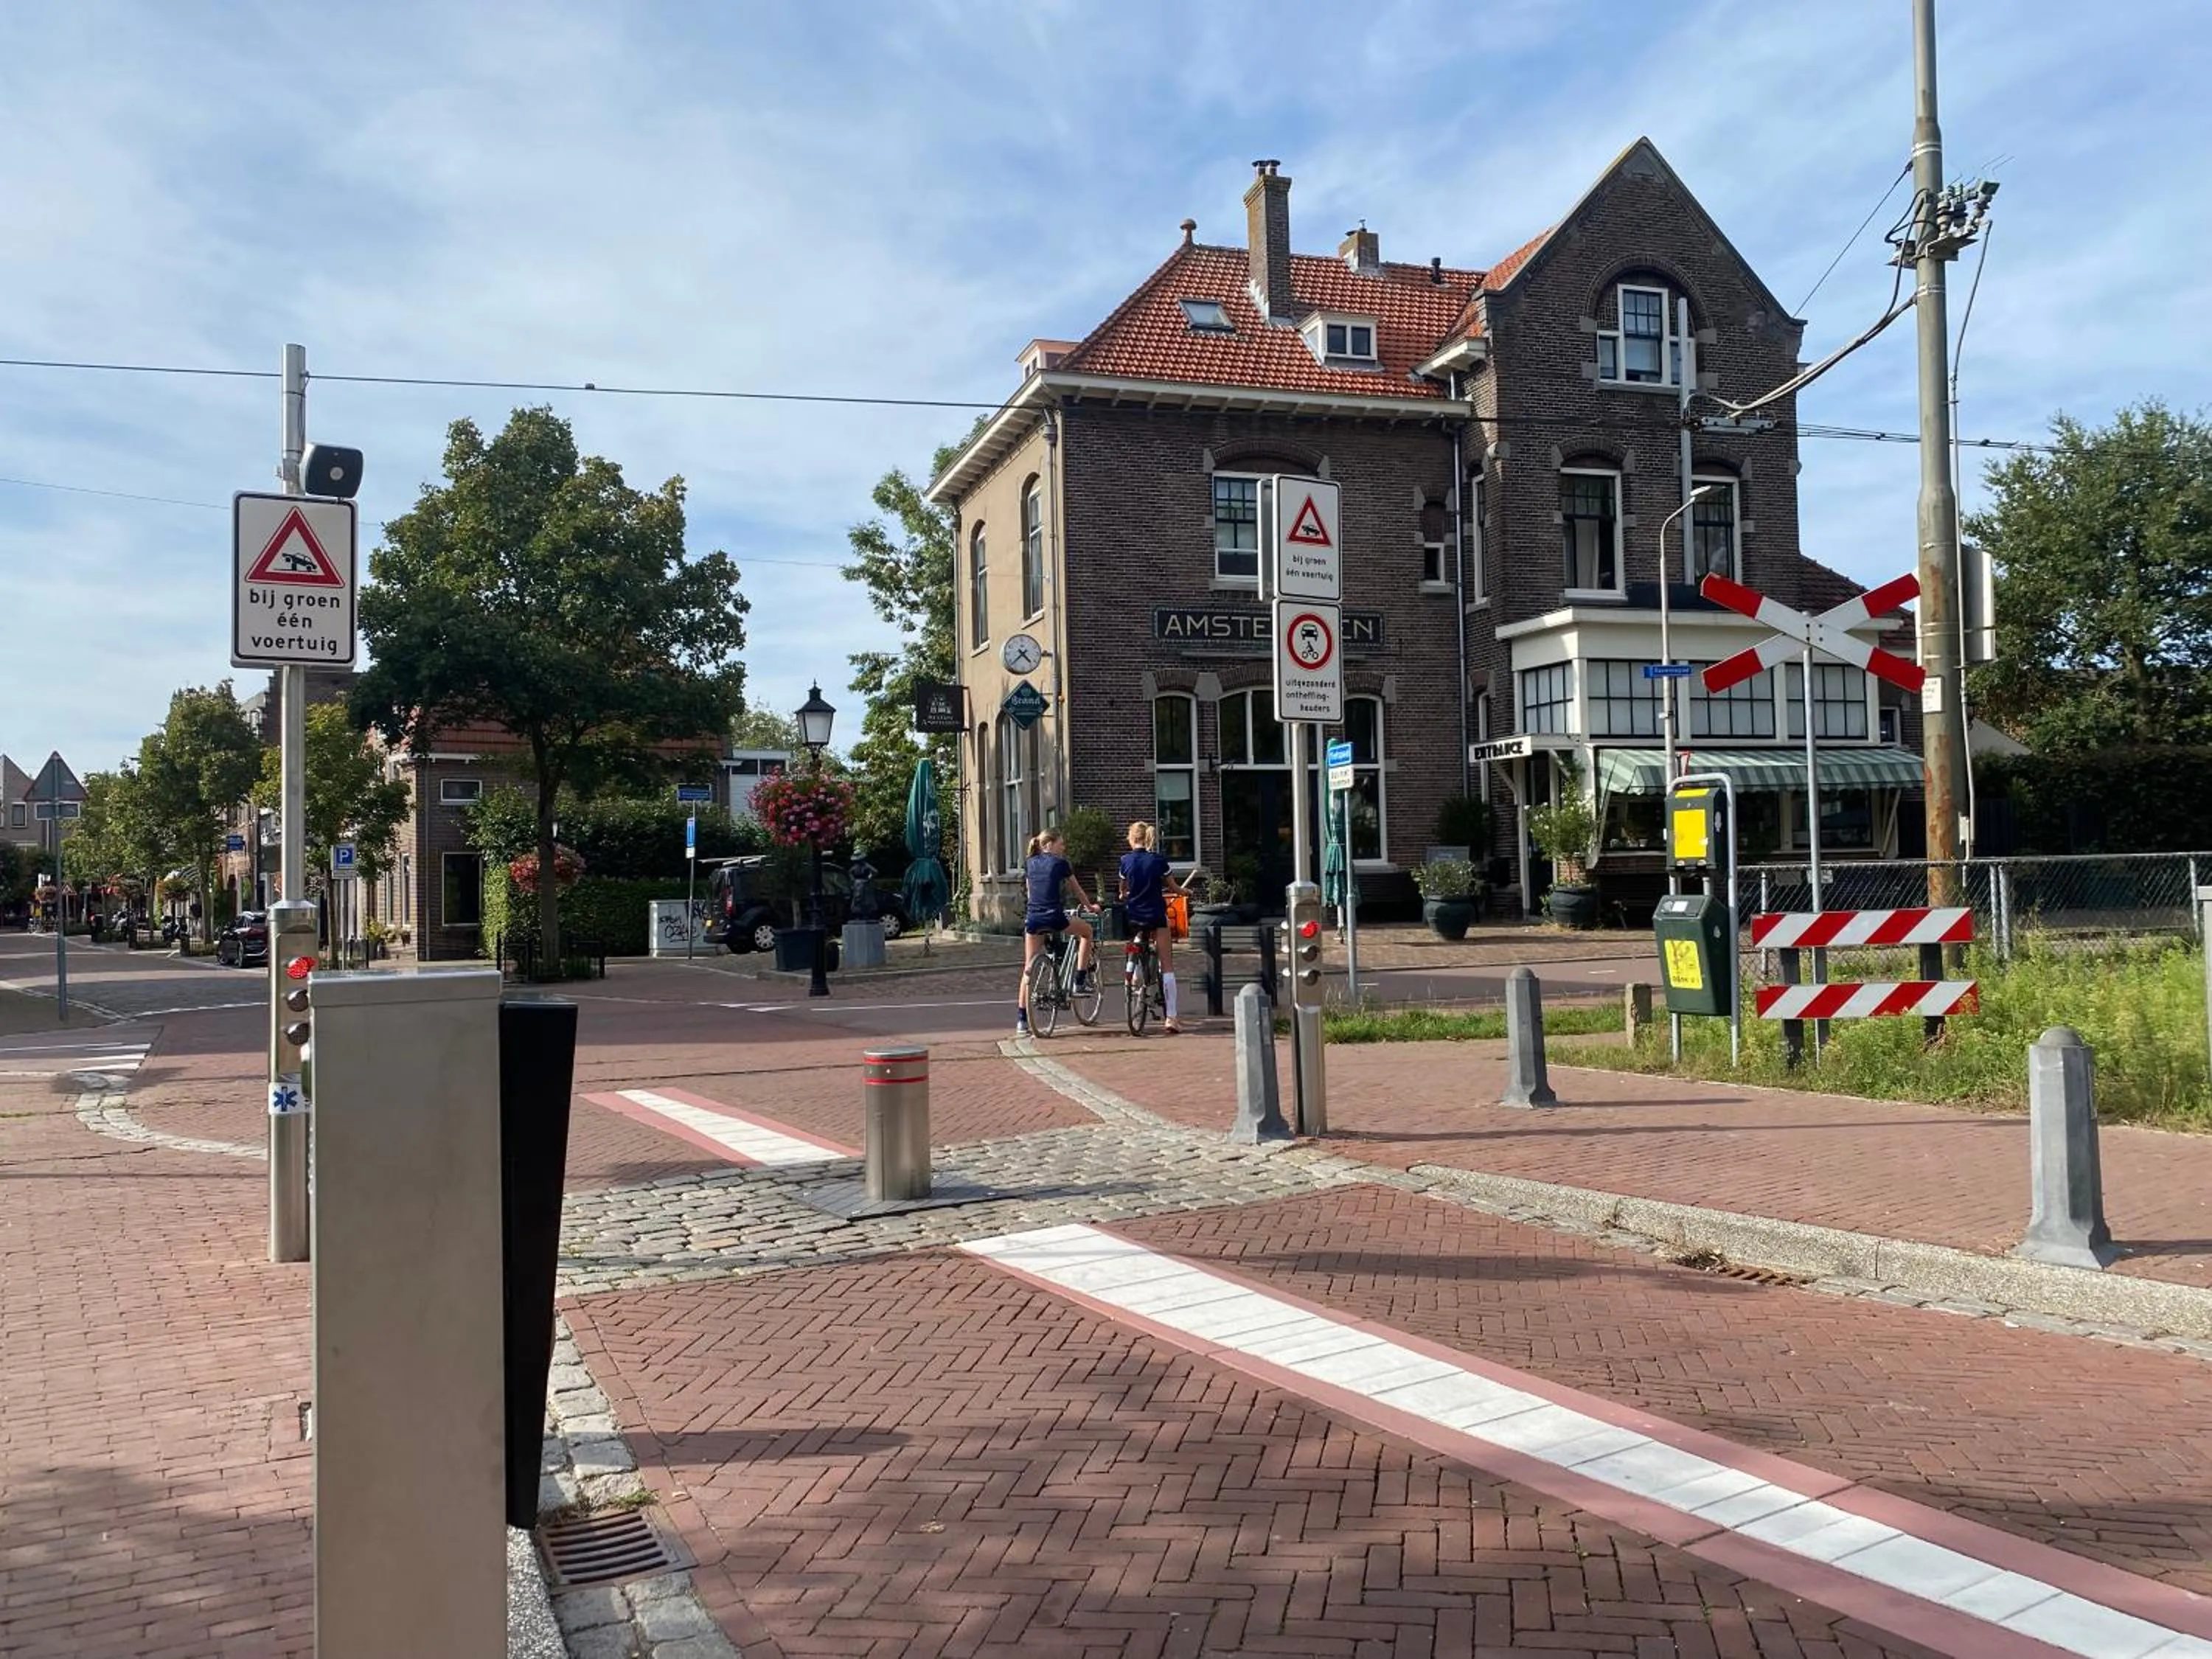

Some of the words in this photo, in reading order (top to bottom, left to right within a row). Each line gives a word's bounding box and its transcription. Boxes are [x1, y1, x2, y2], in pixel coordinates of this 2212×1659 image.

[1293, 554, 1303, 566] bij
[1304, 557, 1326, 566] groen
[1301, 571, 1334, 582] voertuig
[249, 590, 275, 609] bij
[284, 594, 340, 611] groen
[277, 612, 312, 628] één
[251, 635, 338, 655] voertuig
[1285, 678, 1336, 689] uitgezonderd
[1474, 740, 1523, 760] ENTRANCE
[339, 849, 349, 862] P
